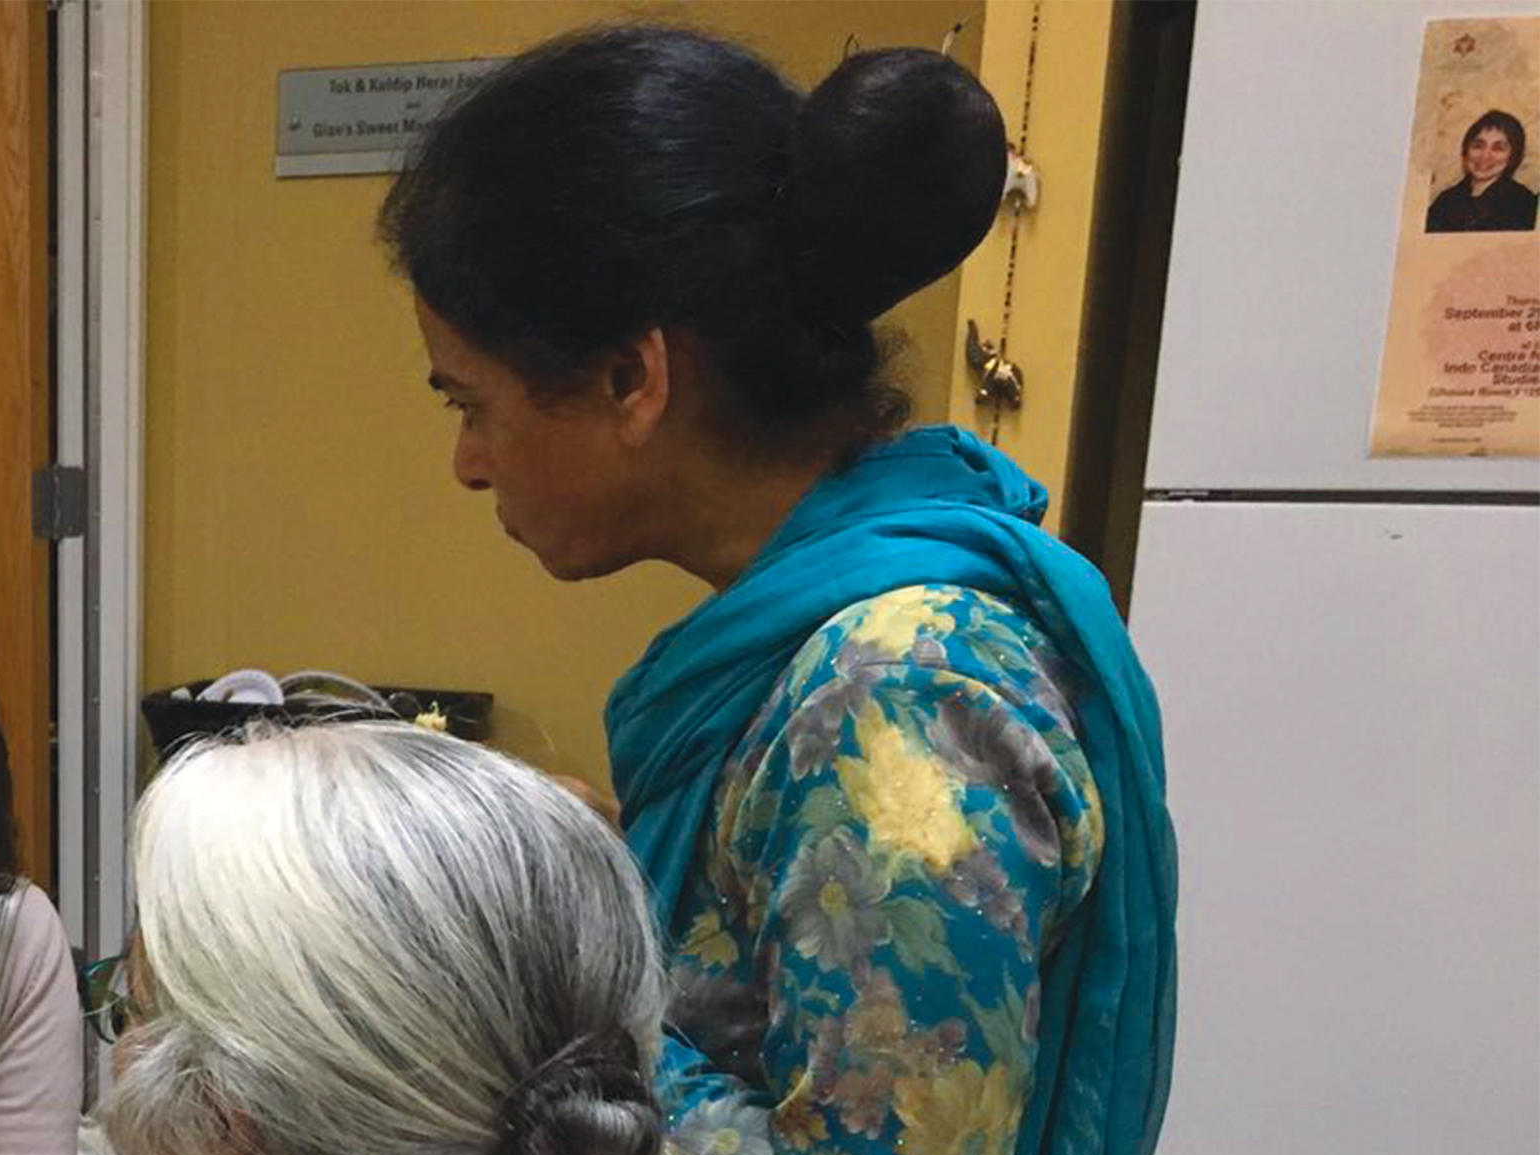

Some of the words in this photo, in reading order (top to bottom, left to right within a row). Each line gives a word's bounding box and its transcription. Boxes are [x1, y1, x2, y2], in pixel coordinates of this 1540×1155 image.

[354, 78, 366, 92] &
[356, 120, 399, 135] Sweet
[1444, 307, 1523, 320] September
[1444, 361, 1477, 373] Indo
